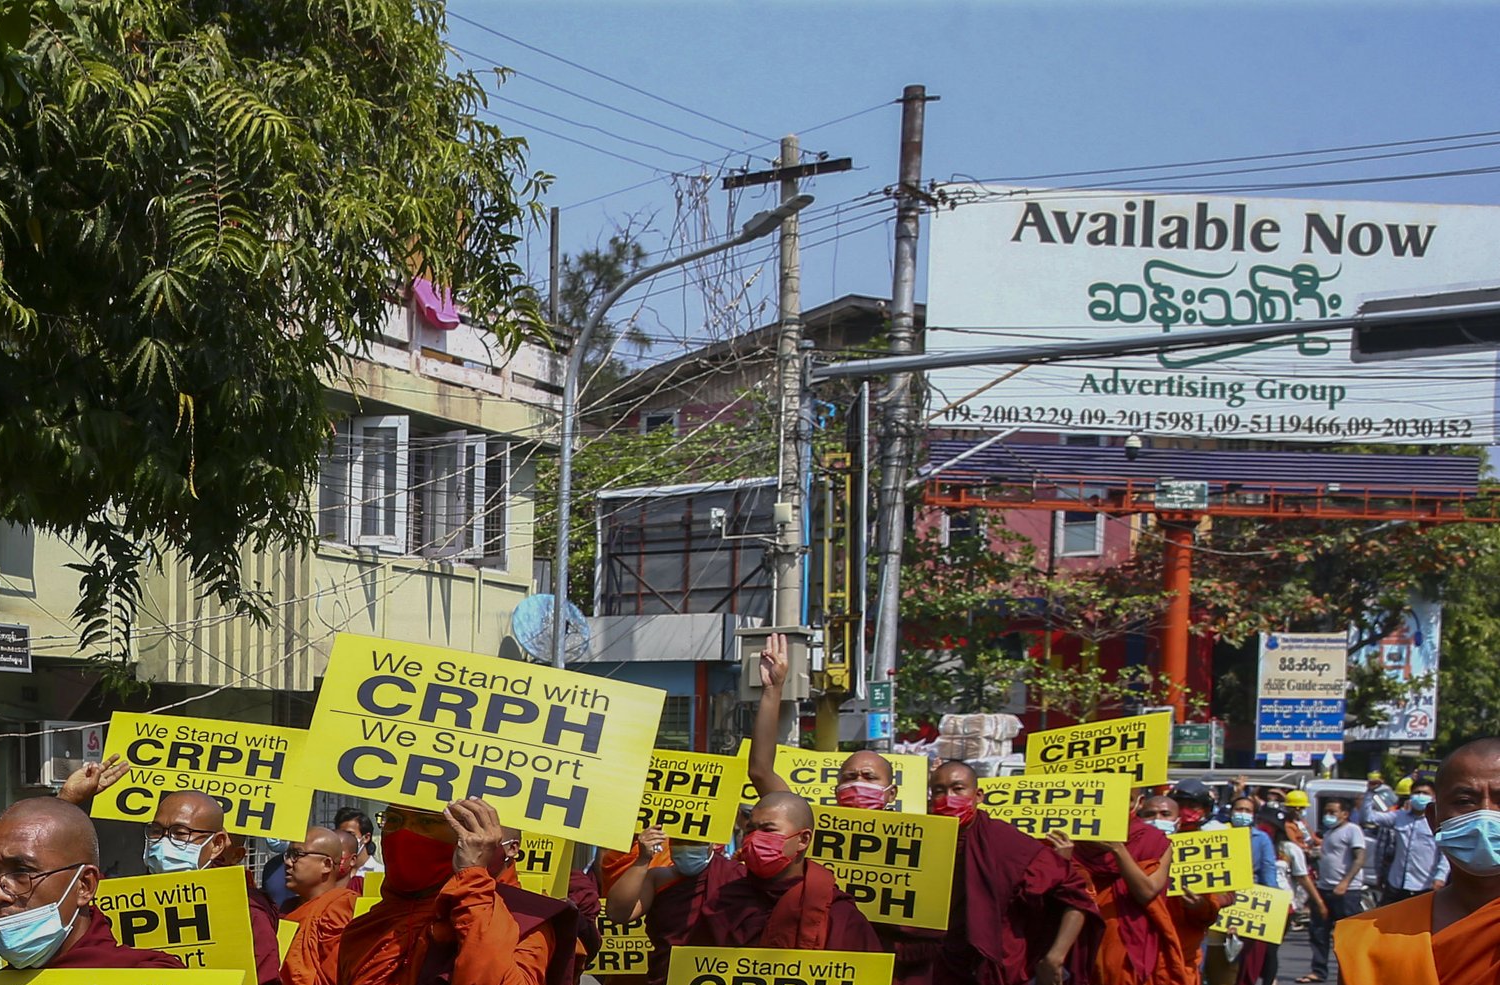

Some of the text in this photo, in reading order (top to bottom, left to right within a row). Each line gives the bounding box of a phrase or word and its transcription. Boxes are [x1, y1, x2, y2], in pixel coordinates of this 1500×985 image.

[1011, 199, 1437, 258] Available Now
[1080, 370, 1346, 410] Advertising Group
[372, 650, 610, 712] We Stand with
[1286, 679, 1317, 692] Guide
[357, 674, 606, 754] CRPH
[1408, 715, 1429, 729] 24
[135, 722, 288, 751] We Stand with
[1043, 720, 1147, 746] We Stand with
[361, 719, 584, 781] We Support
[1040, 731, 1145, 763] CRPH
[126, 738, 286, 780] CRPH
[692, 762, 724, 775] with
[792, 758, 817, 768] We
[823, 758, 844, 768] Sta
[1043, 764, 1068, 775] We
[1074, 752, 1140, 771] Support
[129, 769, 273, 799] We Support
[337, 745, 589, 829] CRPH
[645, 769, 721, 797] RPH
[795, 786, 822, 796] We
[1017, 780, 1065, 788] Stand
[1071, 780, 1105, 788] with
[641, 793, 710, 812] Support
[984, 788, 1103, 806] CRPH
[116, 787, 276, 831] CH
[985, 806, 1097, 819] We Support
[637, 807, 712, 837] RPH
[818, 813, 924, 838] Stand with
[1010, 817, 1100, 836] RPH
[526, 838, 554, 850] with
[812, 829, 922, 868] RPH
[1198, 835, 1229, 844] with
[1172, 843, 1229, 862] PH
[1171, 862, 1225, 874] upport
[1169, 870, 1232, 892] PH
[92, 882, 207, 912] tand with
[835, 883, 916, 919] PH
[1235, 893, 1271, 913] PH
[104, 903, 211, 948] PH
[1215, 914, 1267, 937] PH
[1222, 907, 1265, 922] upport
[599, 917, 643, 935] RP
[605, 938, 653, 951] Suppo
[585, 951, 645, 971] RP
[694, 957, 856, 979] We Stand with
